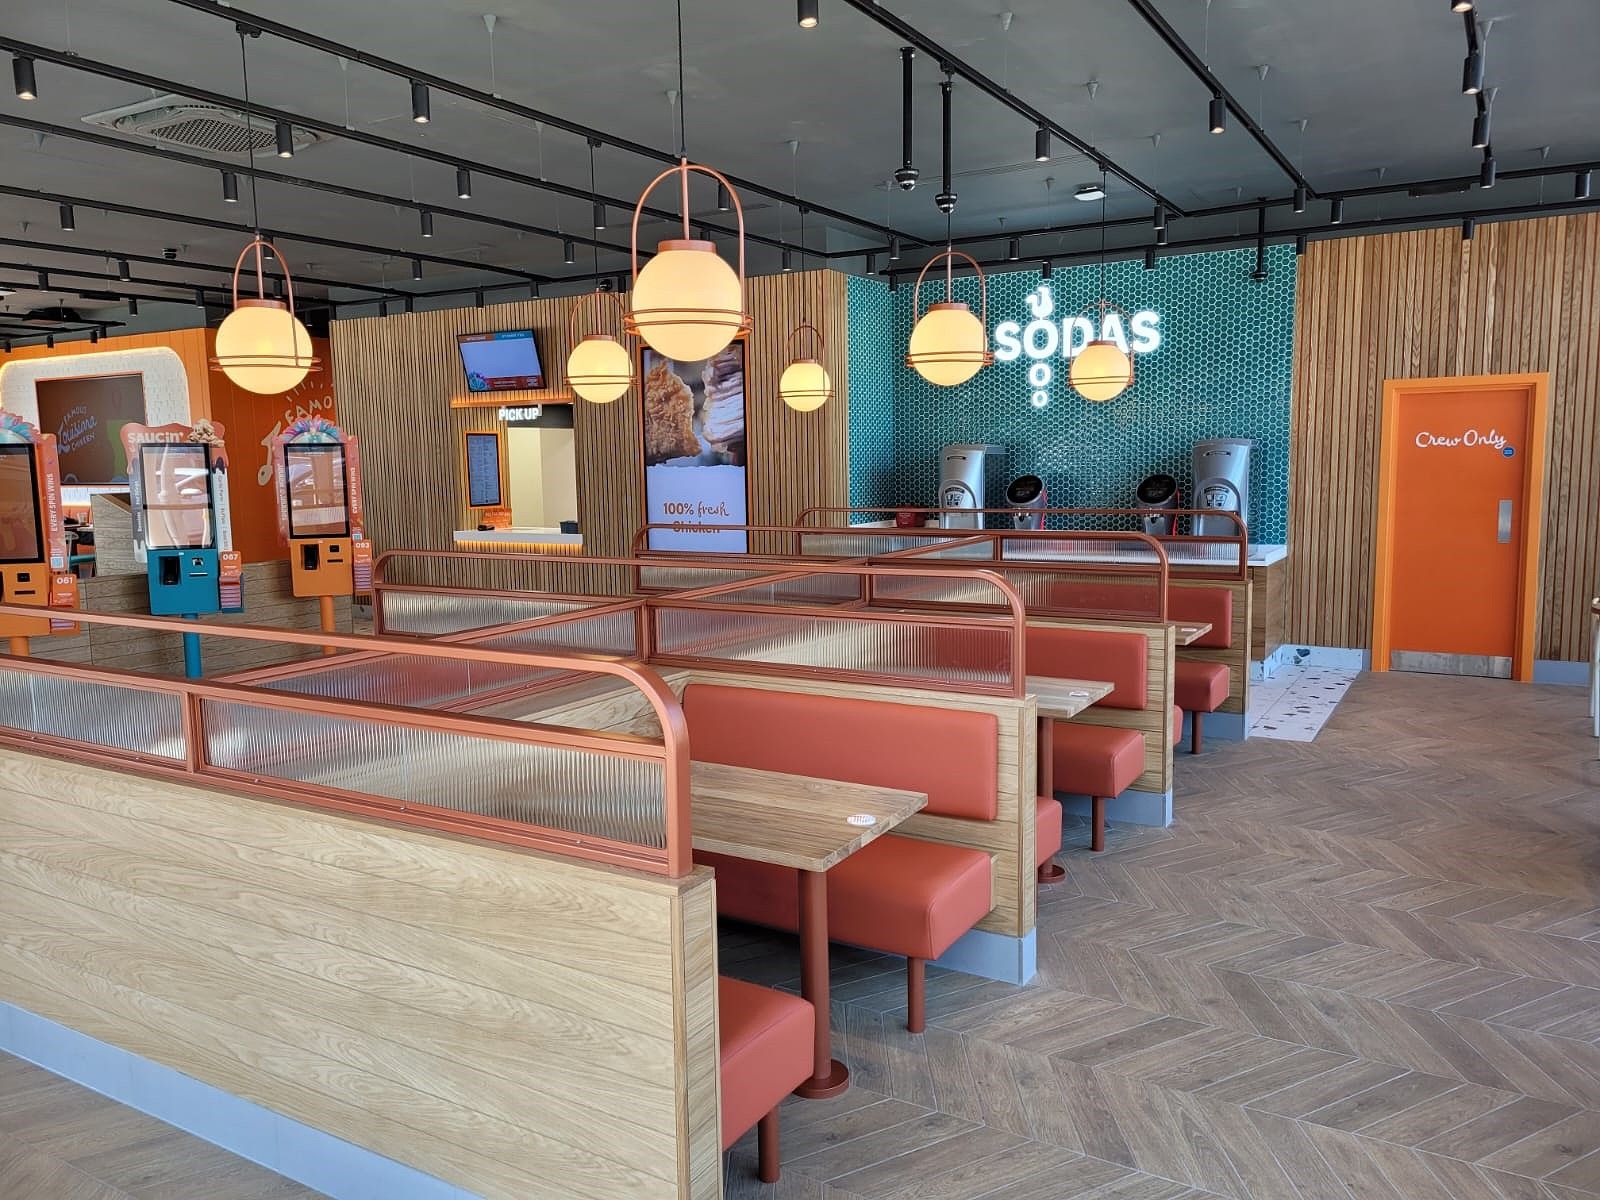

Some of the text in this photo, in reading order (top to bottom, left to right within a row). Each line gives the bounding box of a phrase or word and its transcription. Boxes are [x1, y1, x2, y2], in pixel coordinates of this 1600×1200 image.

[995, 311, 1161, 360] SODAS
[499, 407, 539, 421] PICK UP
[1415, 430, 1506, 449] Crew Only
[46, 473, 58, 531] EVERY SPIN WINS
[663, 501, 730, 518] 100% fresh
